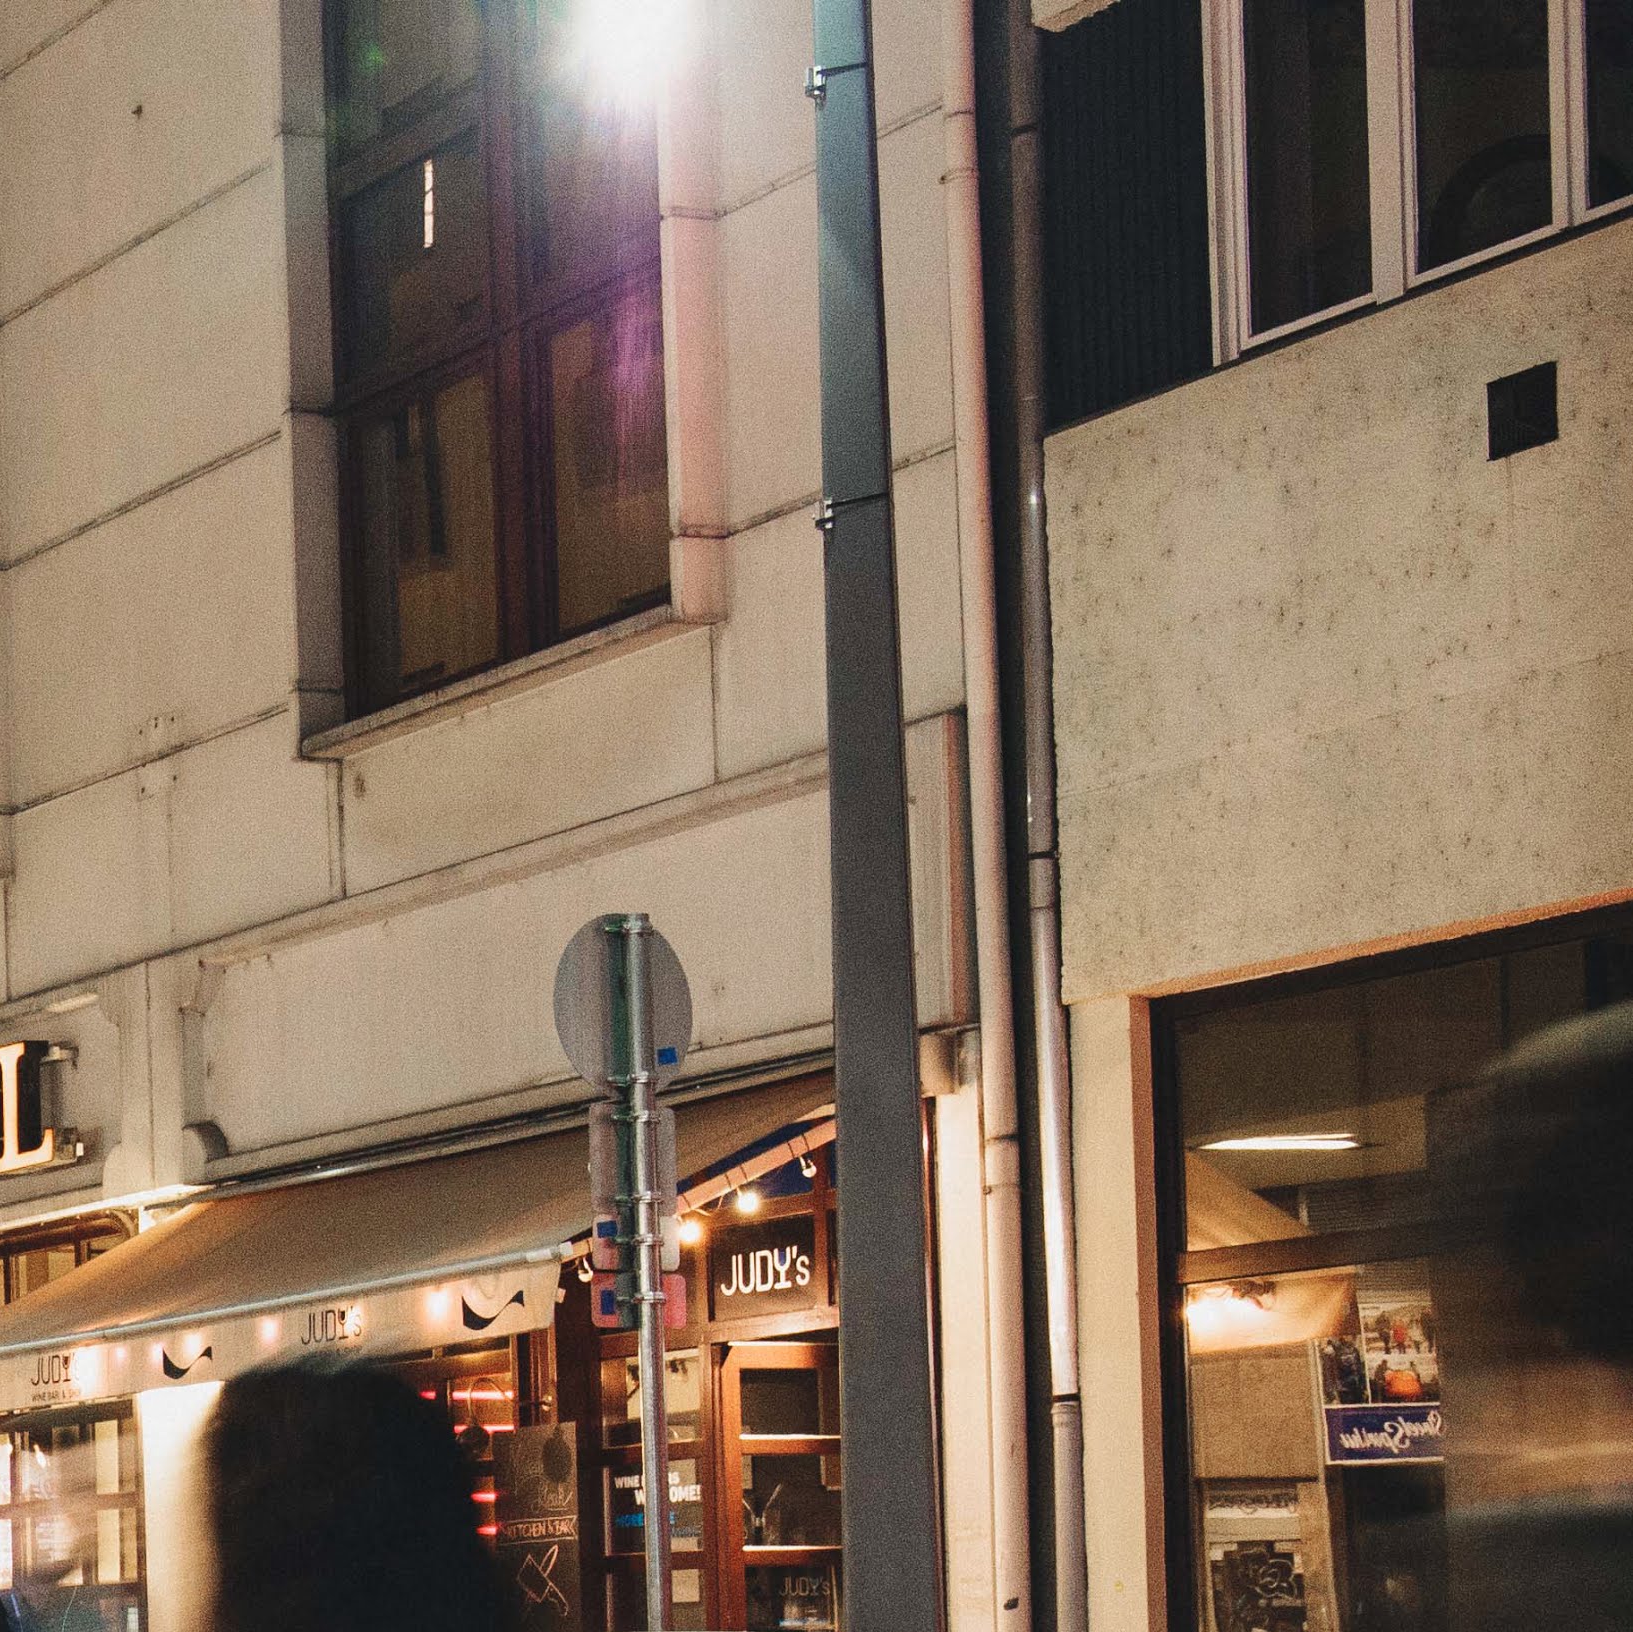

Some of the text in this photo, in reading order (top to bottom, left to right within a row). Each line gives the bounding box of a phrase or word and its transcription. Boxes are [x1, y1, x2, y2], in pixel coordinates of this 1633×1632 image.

[720, 1245, 811, 1296] JUDY's
[300, 1306, 363, 1345] JUDY's
[615, 1475, 640, 1489] WINE
